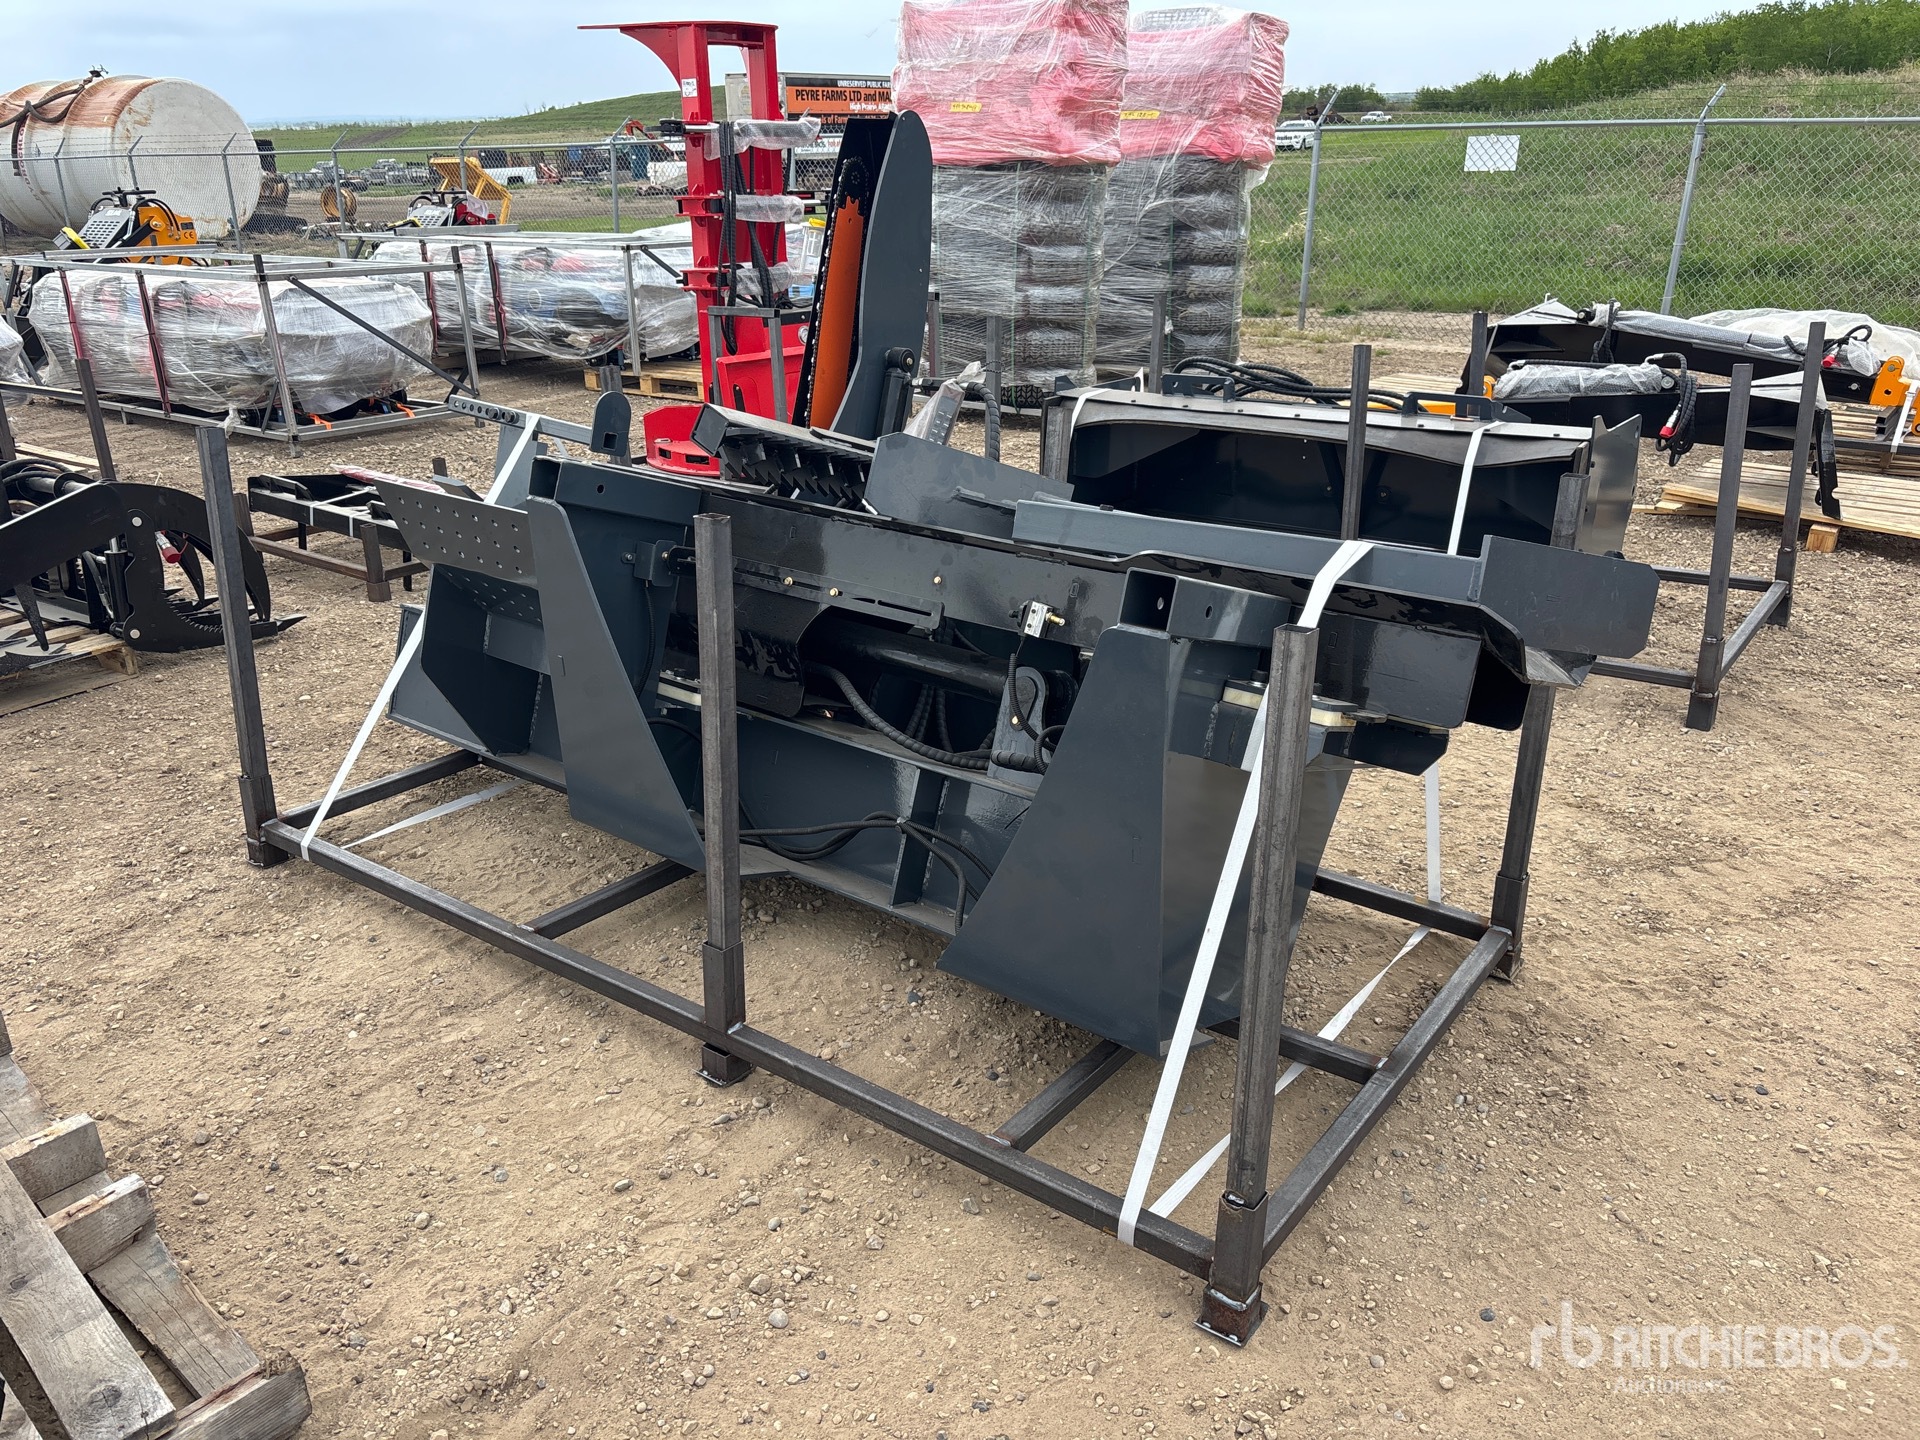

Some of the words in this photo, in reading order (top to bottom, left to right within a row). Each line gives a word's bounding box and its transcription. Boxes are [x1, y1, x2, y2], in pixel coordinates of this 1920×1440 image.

[838, 80, 866, 88] UNRESERVED
[867, 81, 881, 89] PUBLIC
[796, 89, 820, 101] PEYRE
[821, 90, 848, 102] FARMS
[849, 90, 862, 102] LTD
[863, 90, 877, 103] and
[878, 91, 891, 104] MA
[850, 102, 861, 113] High
